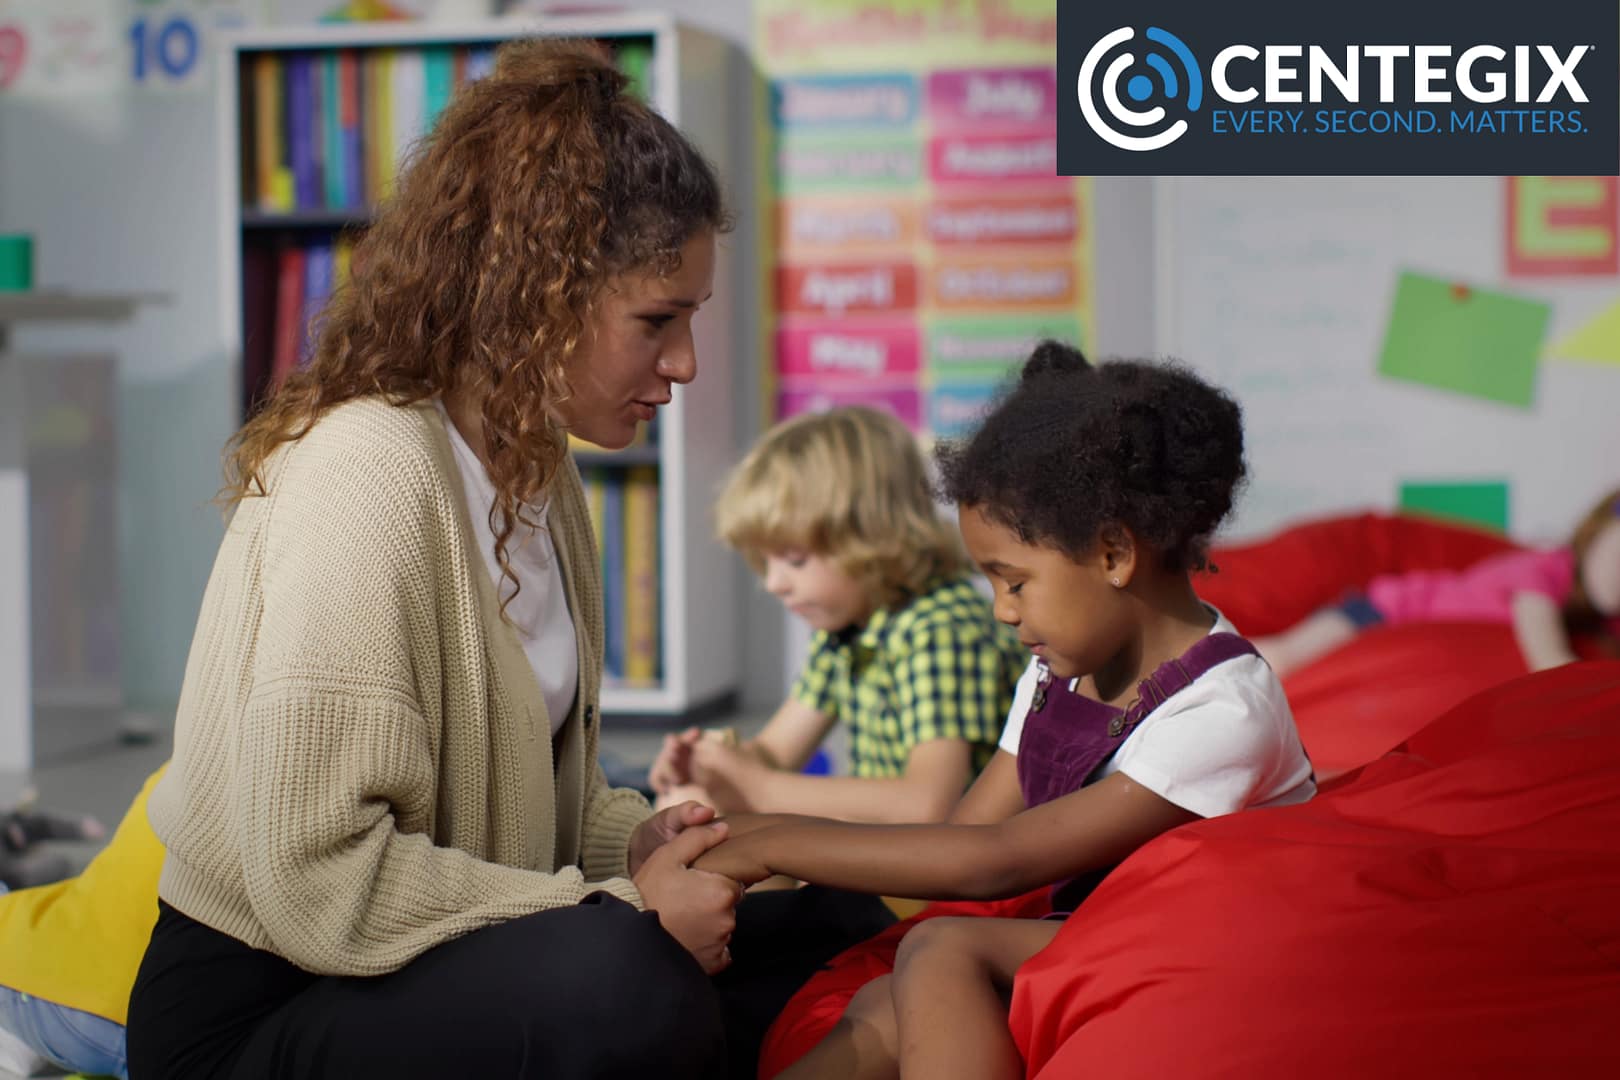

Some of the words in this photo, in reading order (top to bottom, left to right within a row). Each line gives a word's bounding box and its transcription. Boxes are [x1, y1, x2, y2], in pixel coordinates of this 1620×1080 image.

[130, 17, 199, 82] 10
[803, 271, 892, 316] April
[809, 333, 885, 377] May
